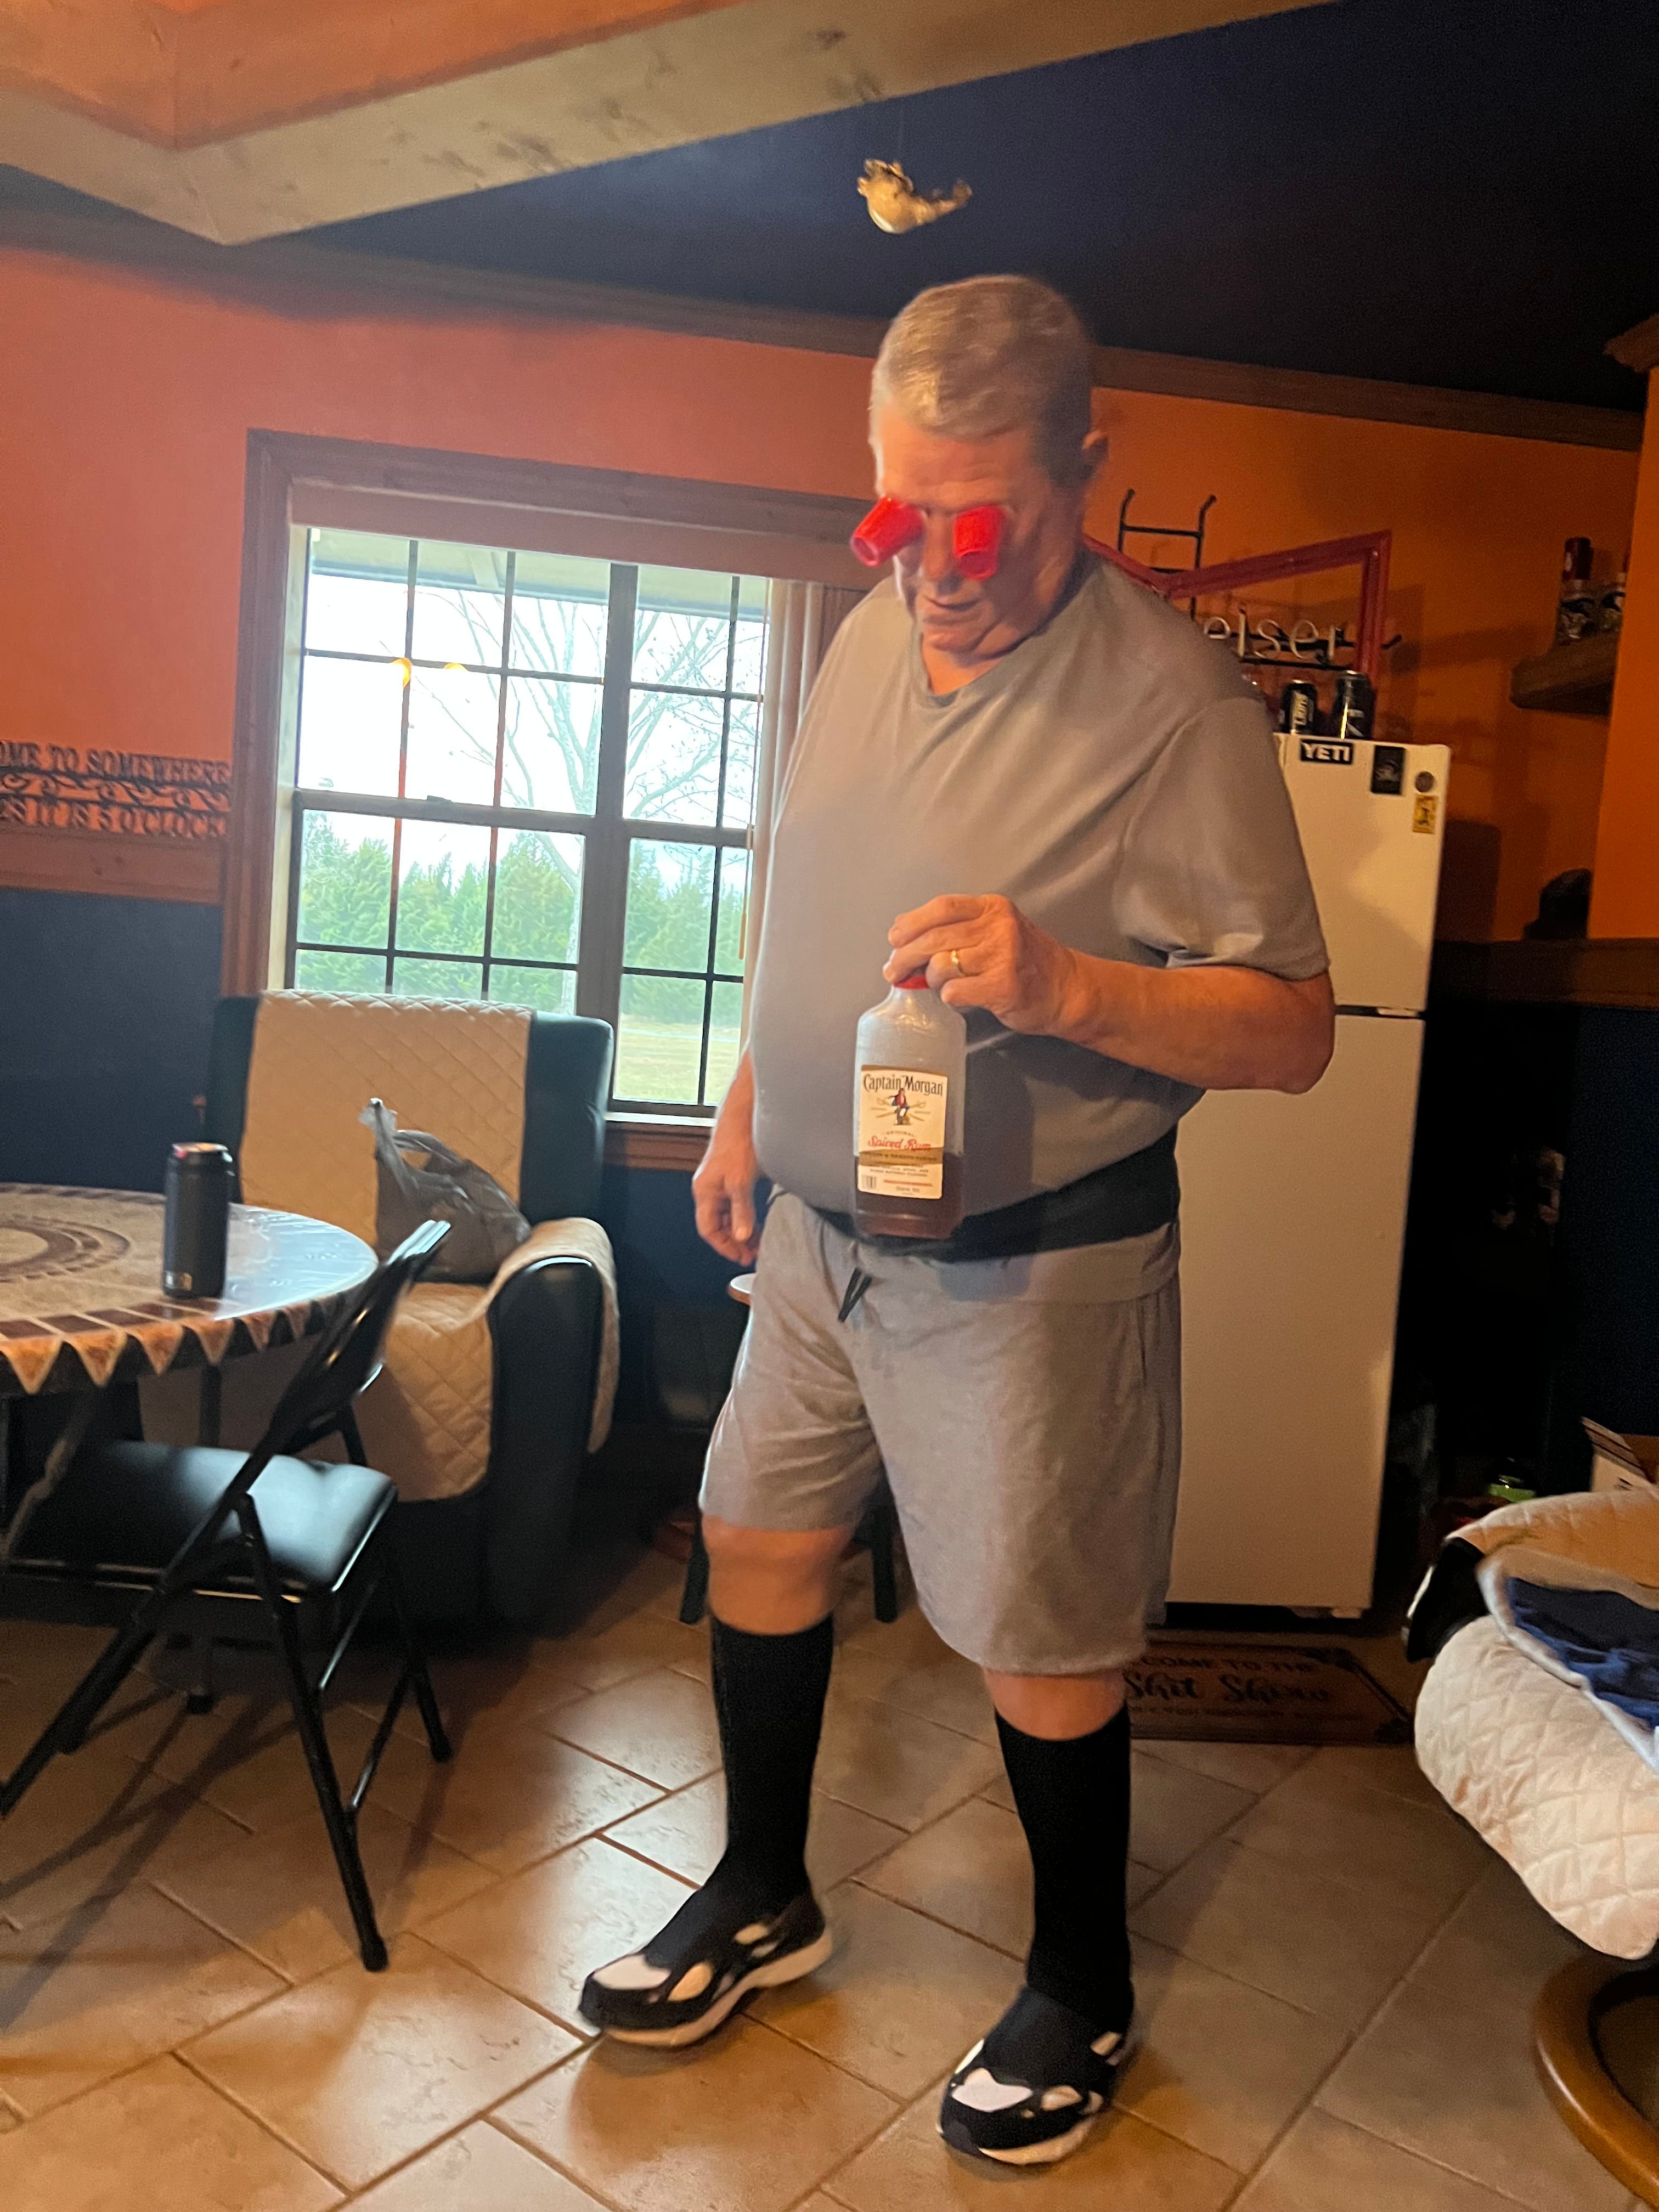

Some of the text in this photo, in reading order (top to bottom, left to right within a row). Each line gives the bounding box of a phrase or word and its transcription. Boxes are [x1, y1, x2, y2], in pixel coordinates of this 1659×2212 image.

[1301, 742, 1350, 762] YETI
[864, 1074, 944, 1097] Captain Morgan
[868, 1135, 931, 1151] Spiced Rum
